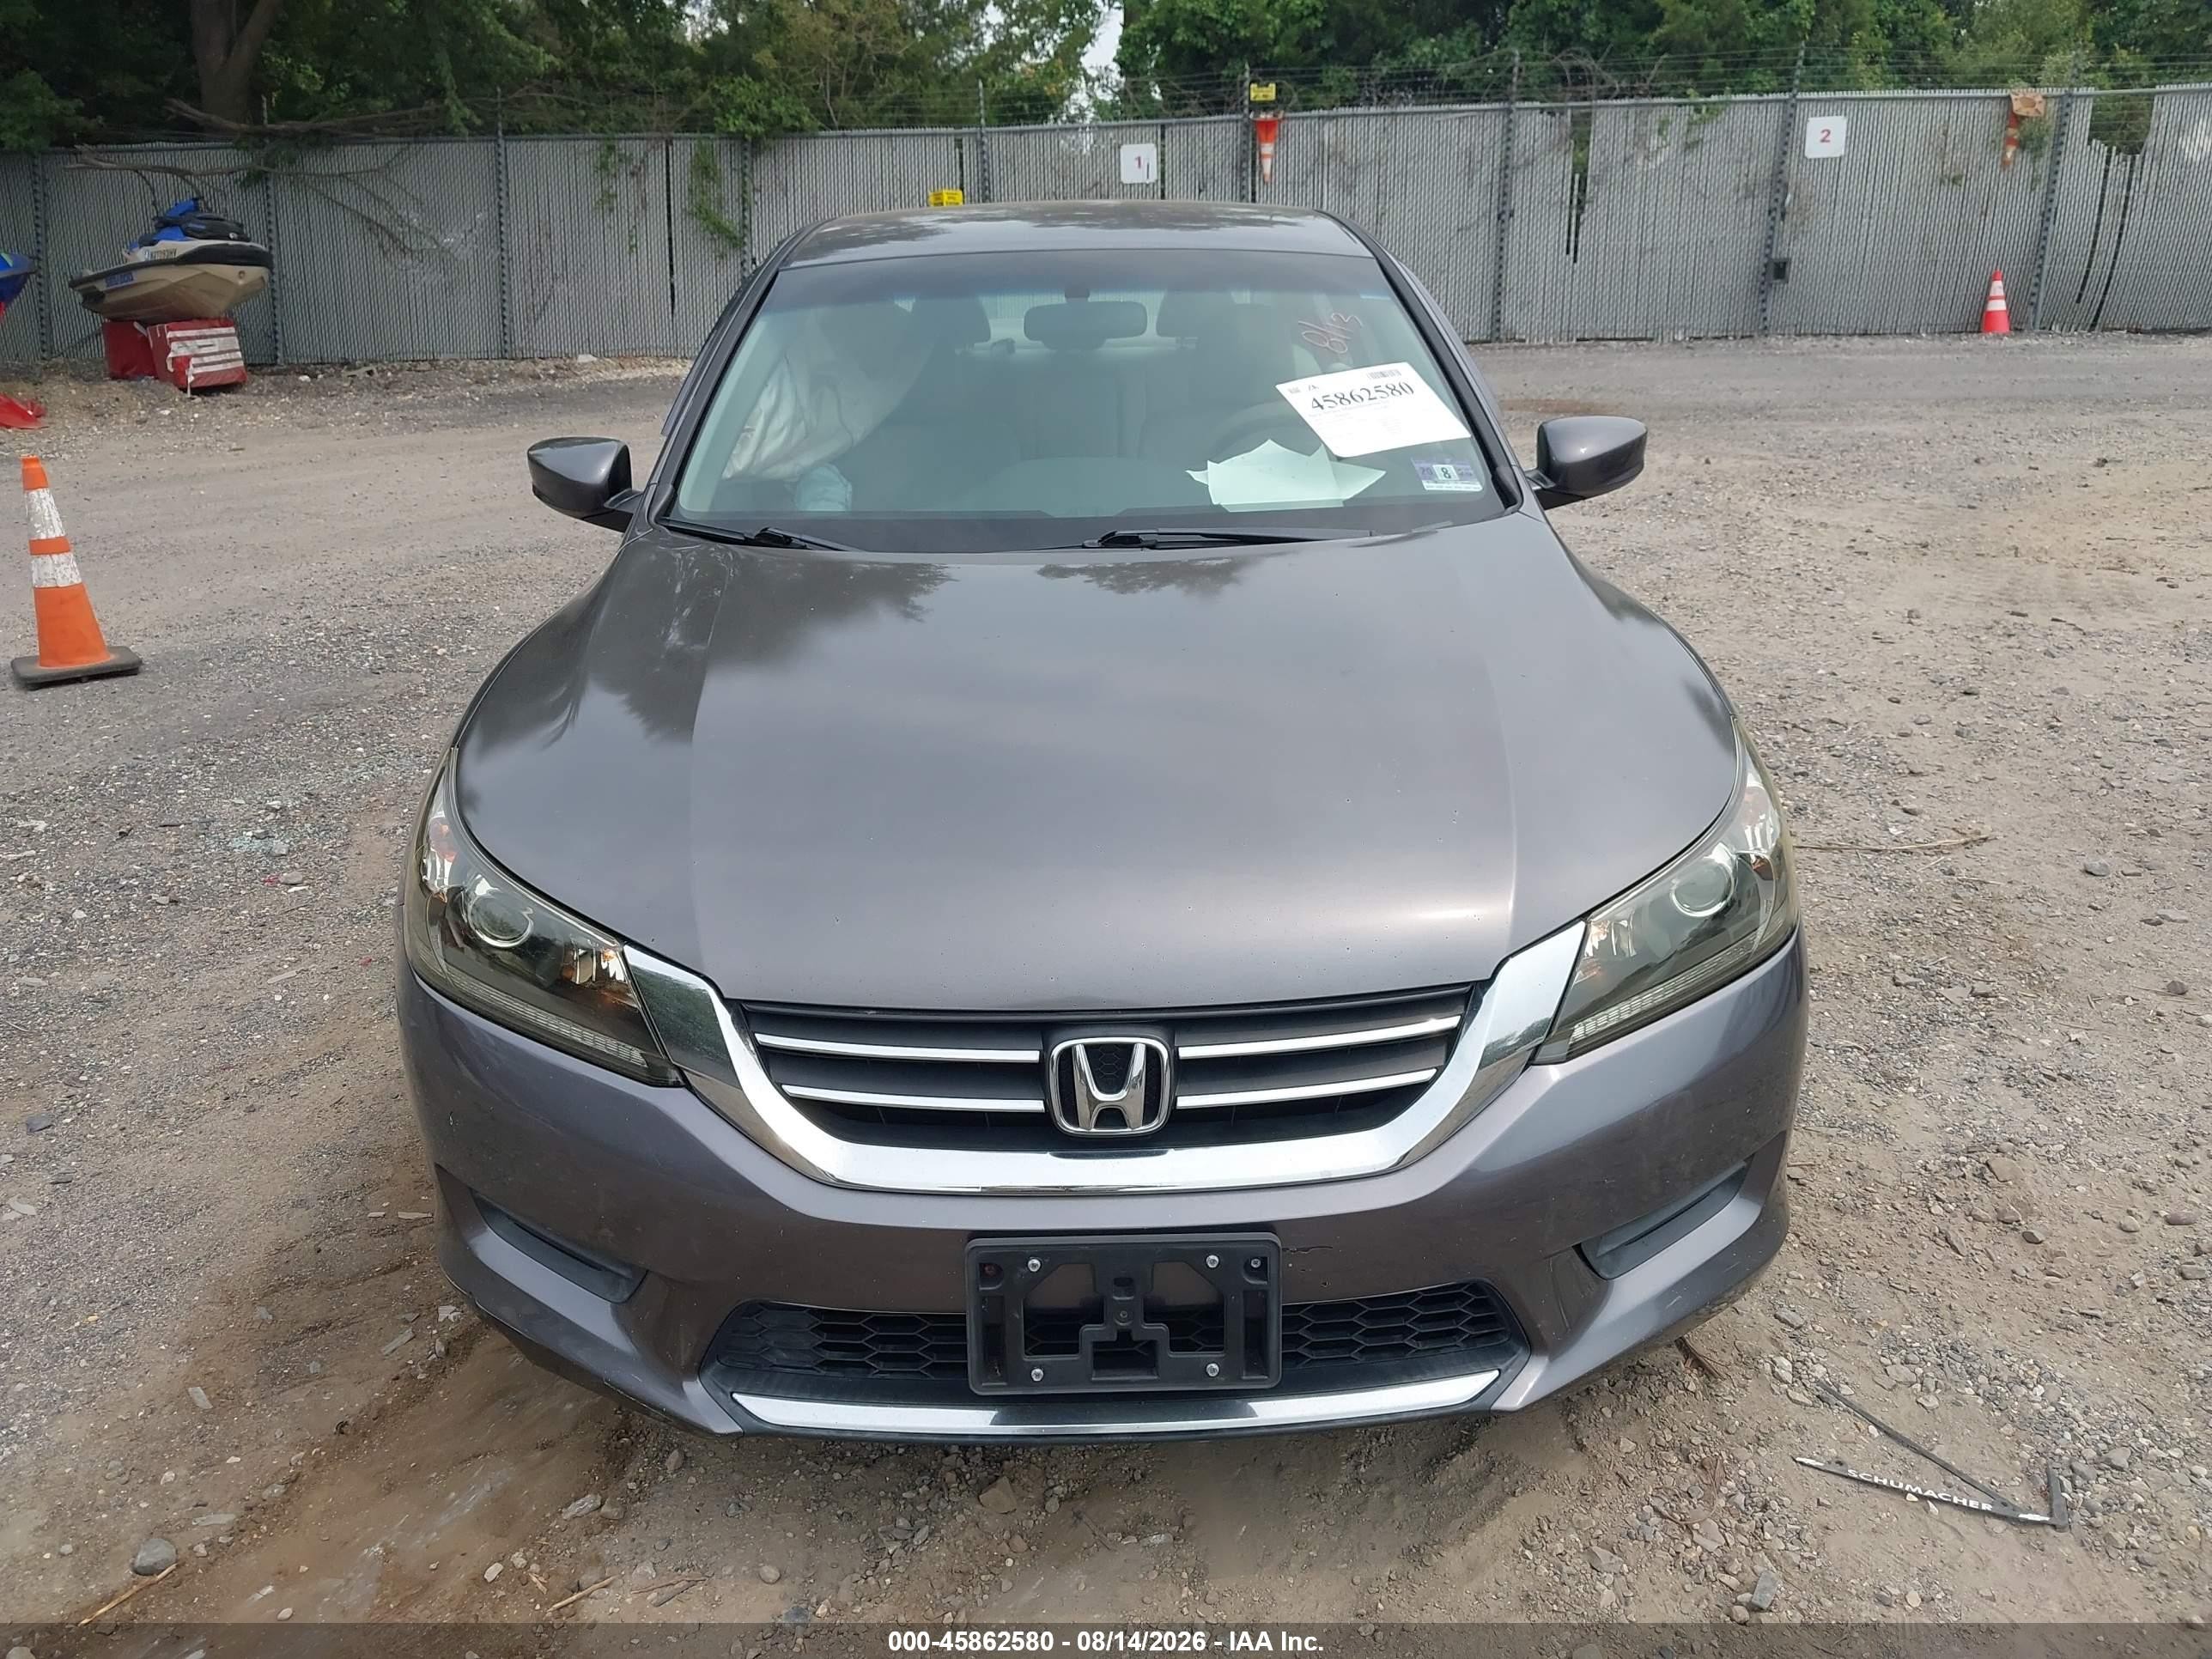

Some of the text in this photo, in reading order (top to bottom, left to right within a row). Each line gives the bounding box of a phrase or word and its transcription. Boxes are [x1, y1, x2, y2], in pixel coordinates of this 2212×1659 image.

[1820, 129, 1831, 143] 2
[1311, 380, 1414, 410] 45862580
[1441, 466, 1452, 479] 8
[1847, 1468, 1993, 1511] SCHUMACHER
